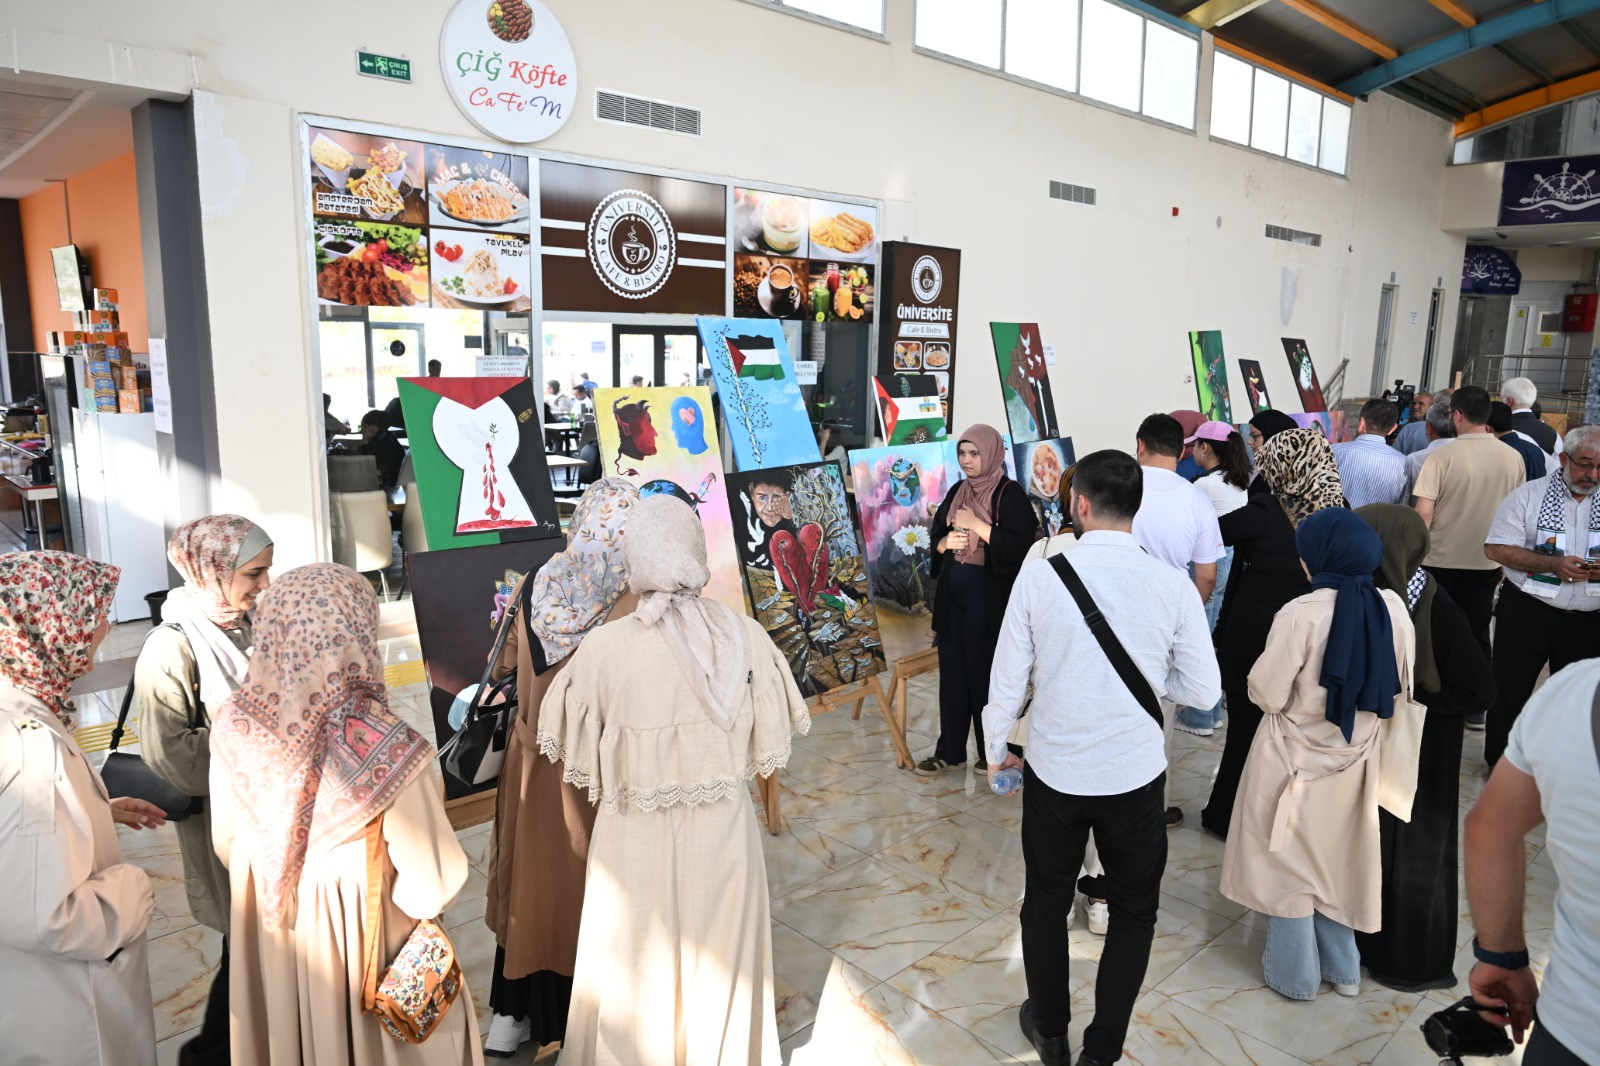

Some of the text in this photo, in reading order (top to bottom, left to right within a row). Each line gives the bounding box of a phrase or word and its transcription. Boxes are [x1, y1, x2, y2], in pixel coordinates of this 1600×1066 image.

[391, 69, 407, 77] EXIT
[456, 49, 567, 89] ÇİĞ Köfte
[434, 165, 460, 186] MAC
[460, 162, 472, 175] &
[599, 200, 666, 238] ÜNİVERSİTE
[600, 250, 666, 288] CAFE & BİSTRO
[896, 303, 953, 322] ÜNİVERSİTE
[907, 326, 920, 334] Cafe
[926, 327, 942, 335] Bistro
